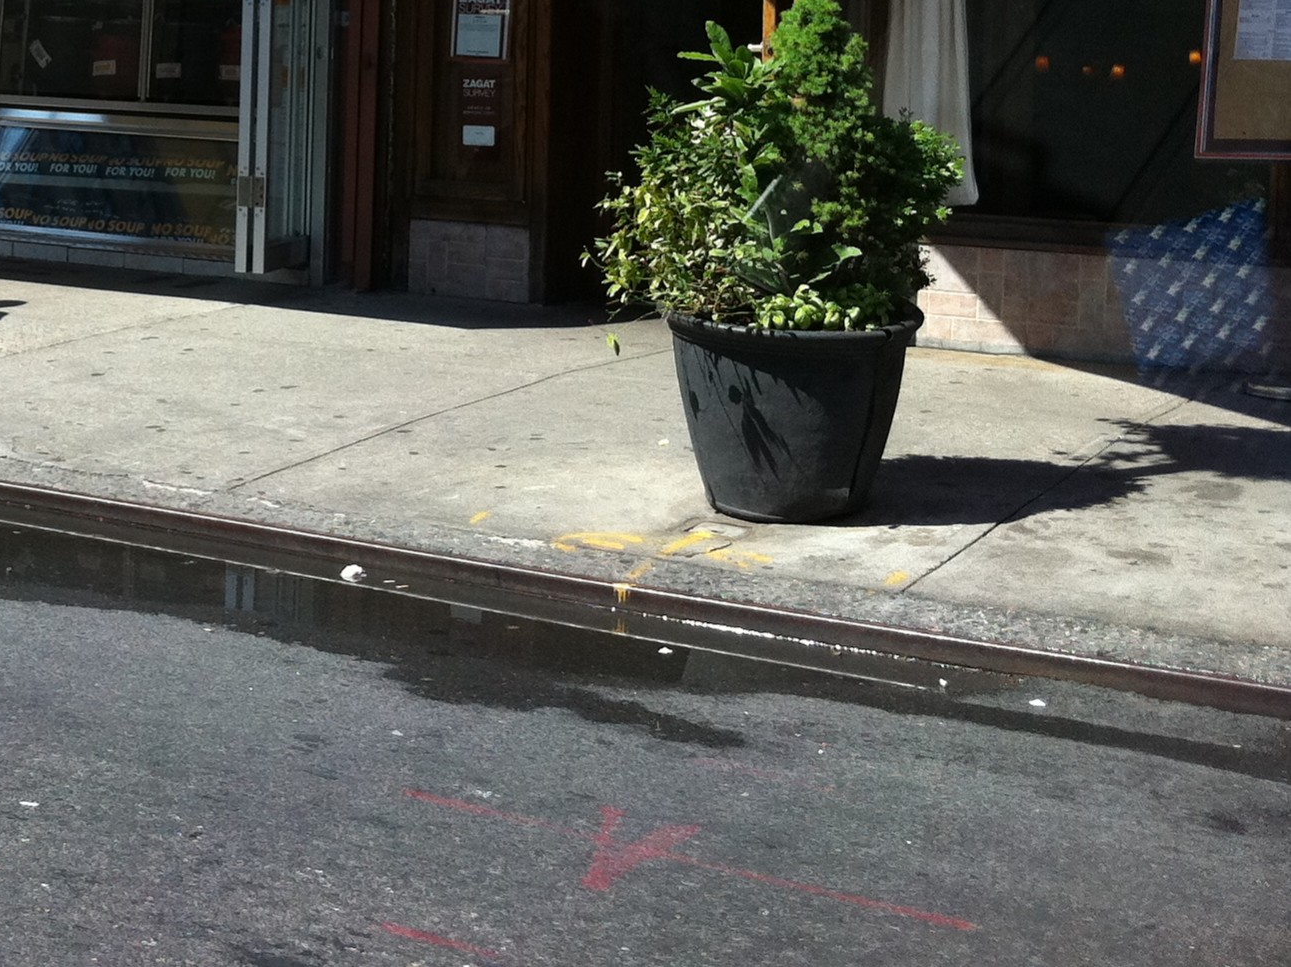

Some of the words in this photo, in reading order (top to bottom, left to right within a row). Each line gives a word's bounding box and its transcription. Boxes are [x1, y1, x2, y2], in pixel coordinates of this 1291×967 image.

[462, 78, 496, 89] ZAGAT
[462, 89, 496, 98] SURVEY
[49, 163, 70, 174] FOR
[72, 163, 98, 174] YOU!
[105, 166, 126, 176] FOR
[128, 166, 156, 178] YOU!
[164, 167, 187, 177] FOR
[190, 167, 216, 179] YOU!
[52, 215, 88, 227] SOUP
[106, 219, 146, 233] SOUP
